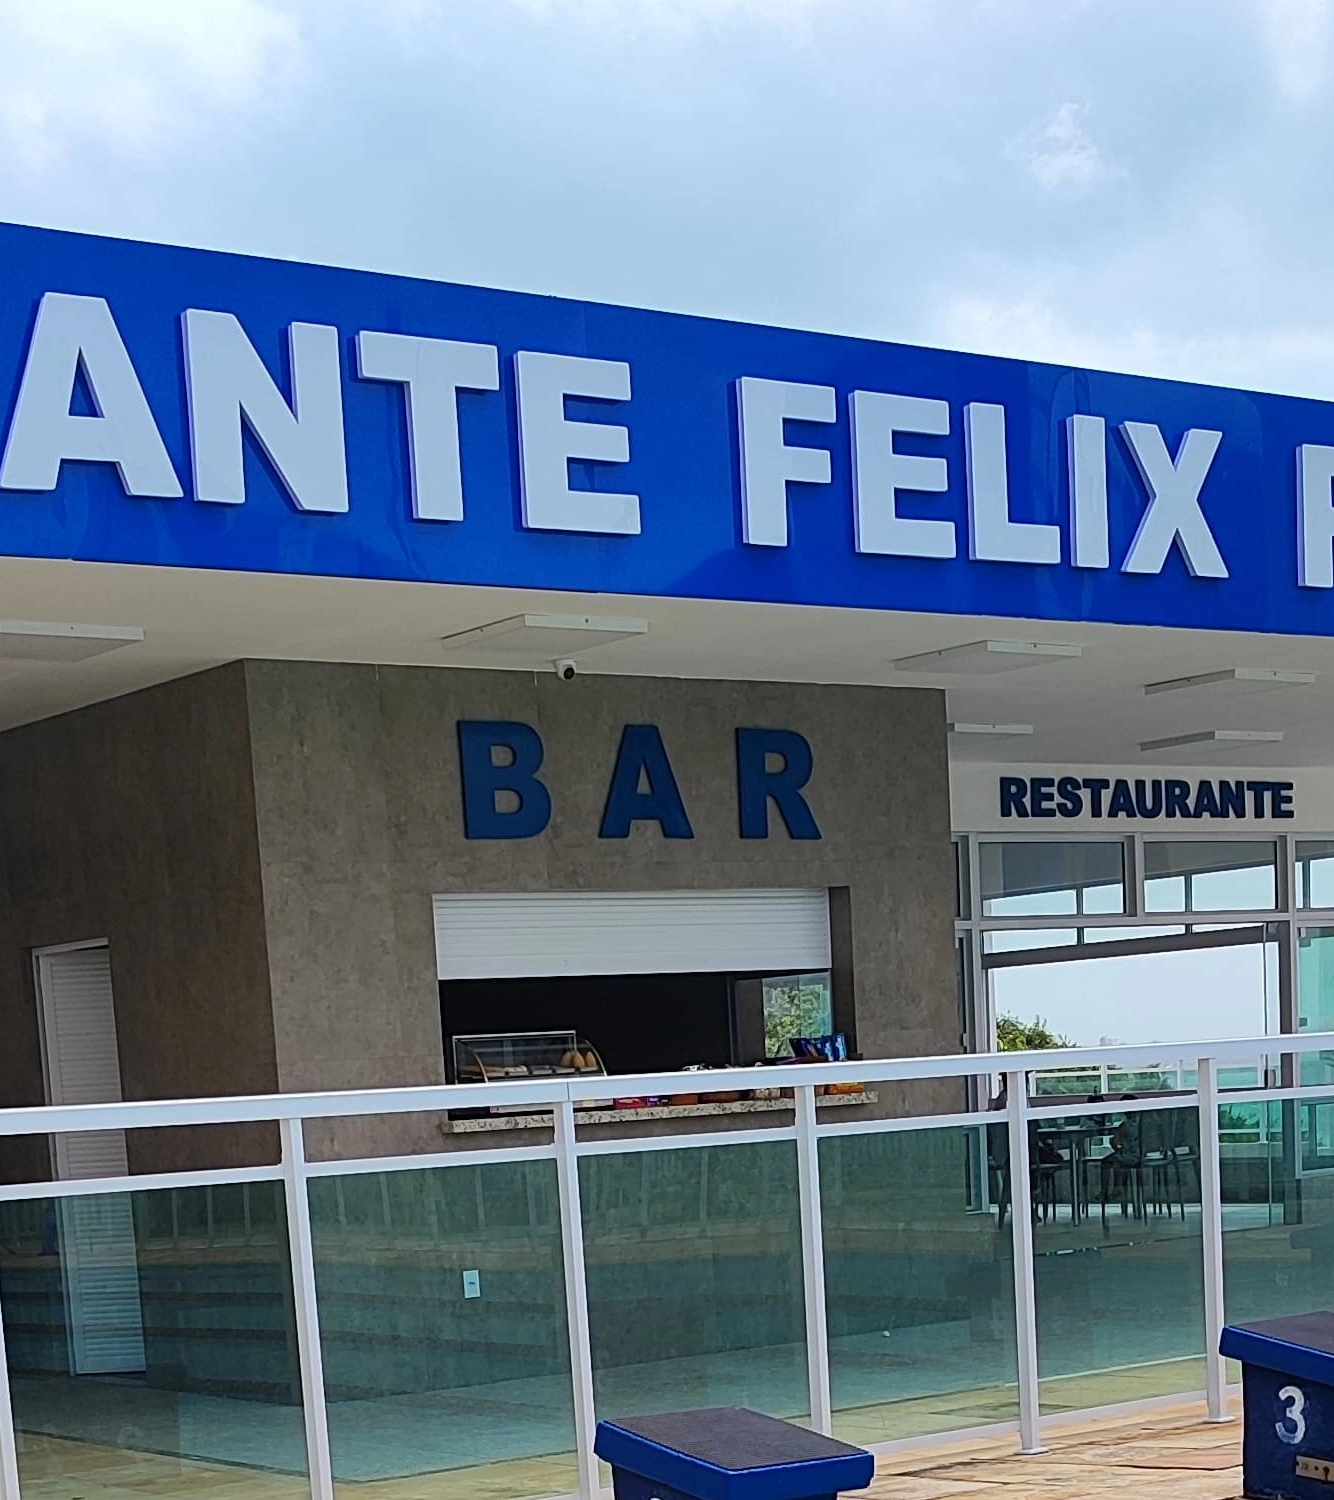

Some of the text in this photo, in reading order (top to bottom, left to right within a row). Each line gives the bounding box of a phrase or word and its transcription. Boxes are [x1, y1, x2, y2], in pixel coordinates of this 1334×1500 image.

[736, 376, 1229, 578] FELIX
[457, 718, 822, 840] BAR
[999, 776, 1295, 820] RESTAURANTE
[1274, 1385, 1307, 1445] 3
